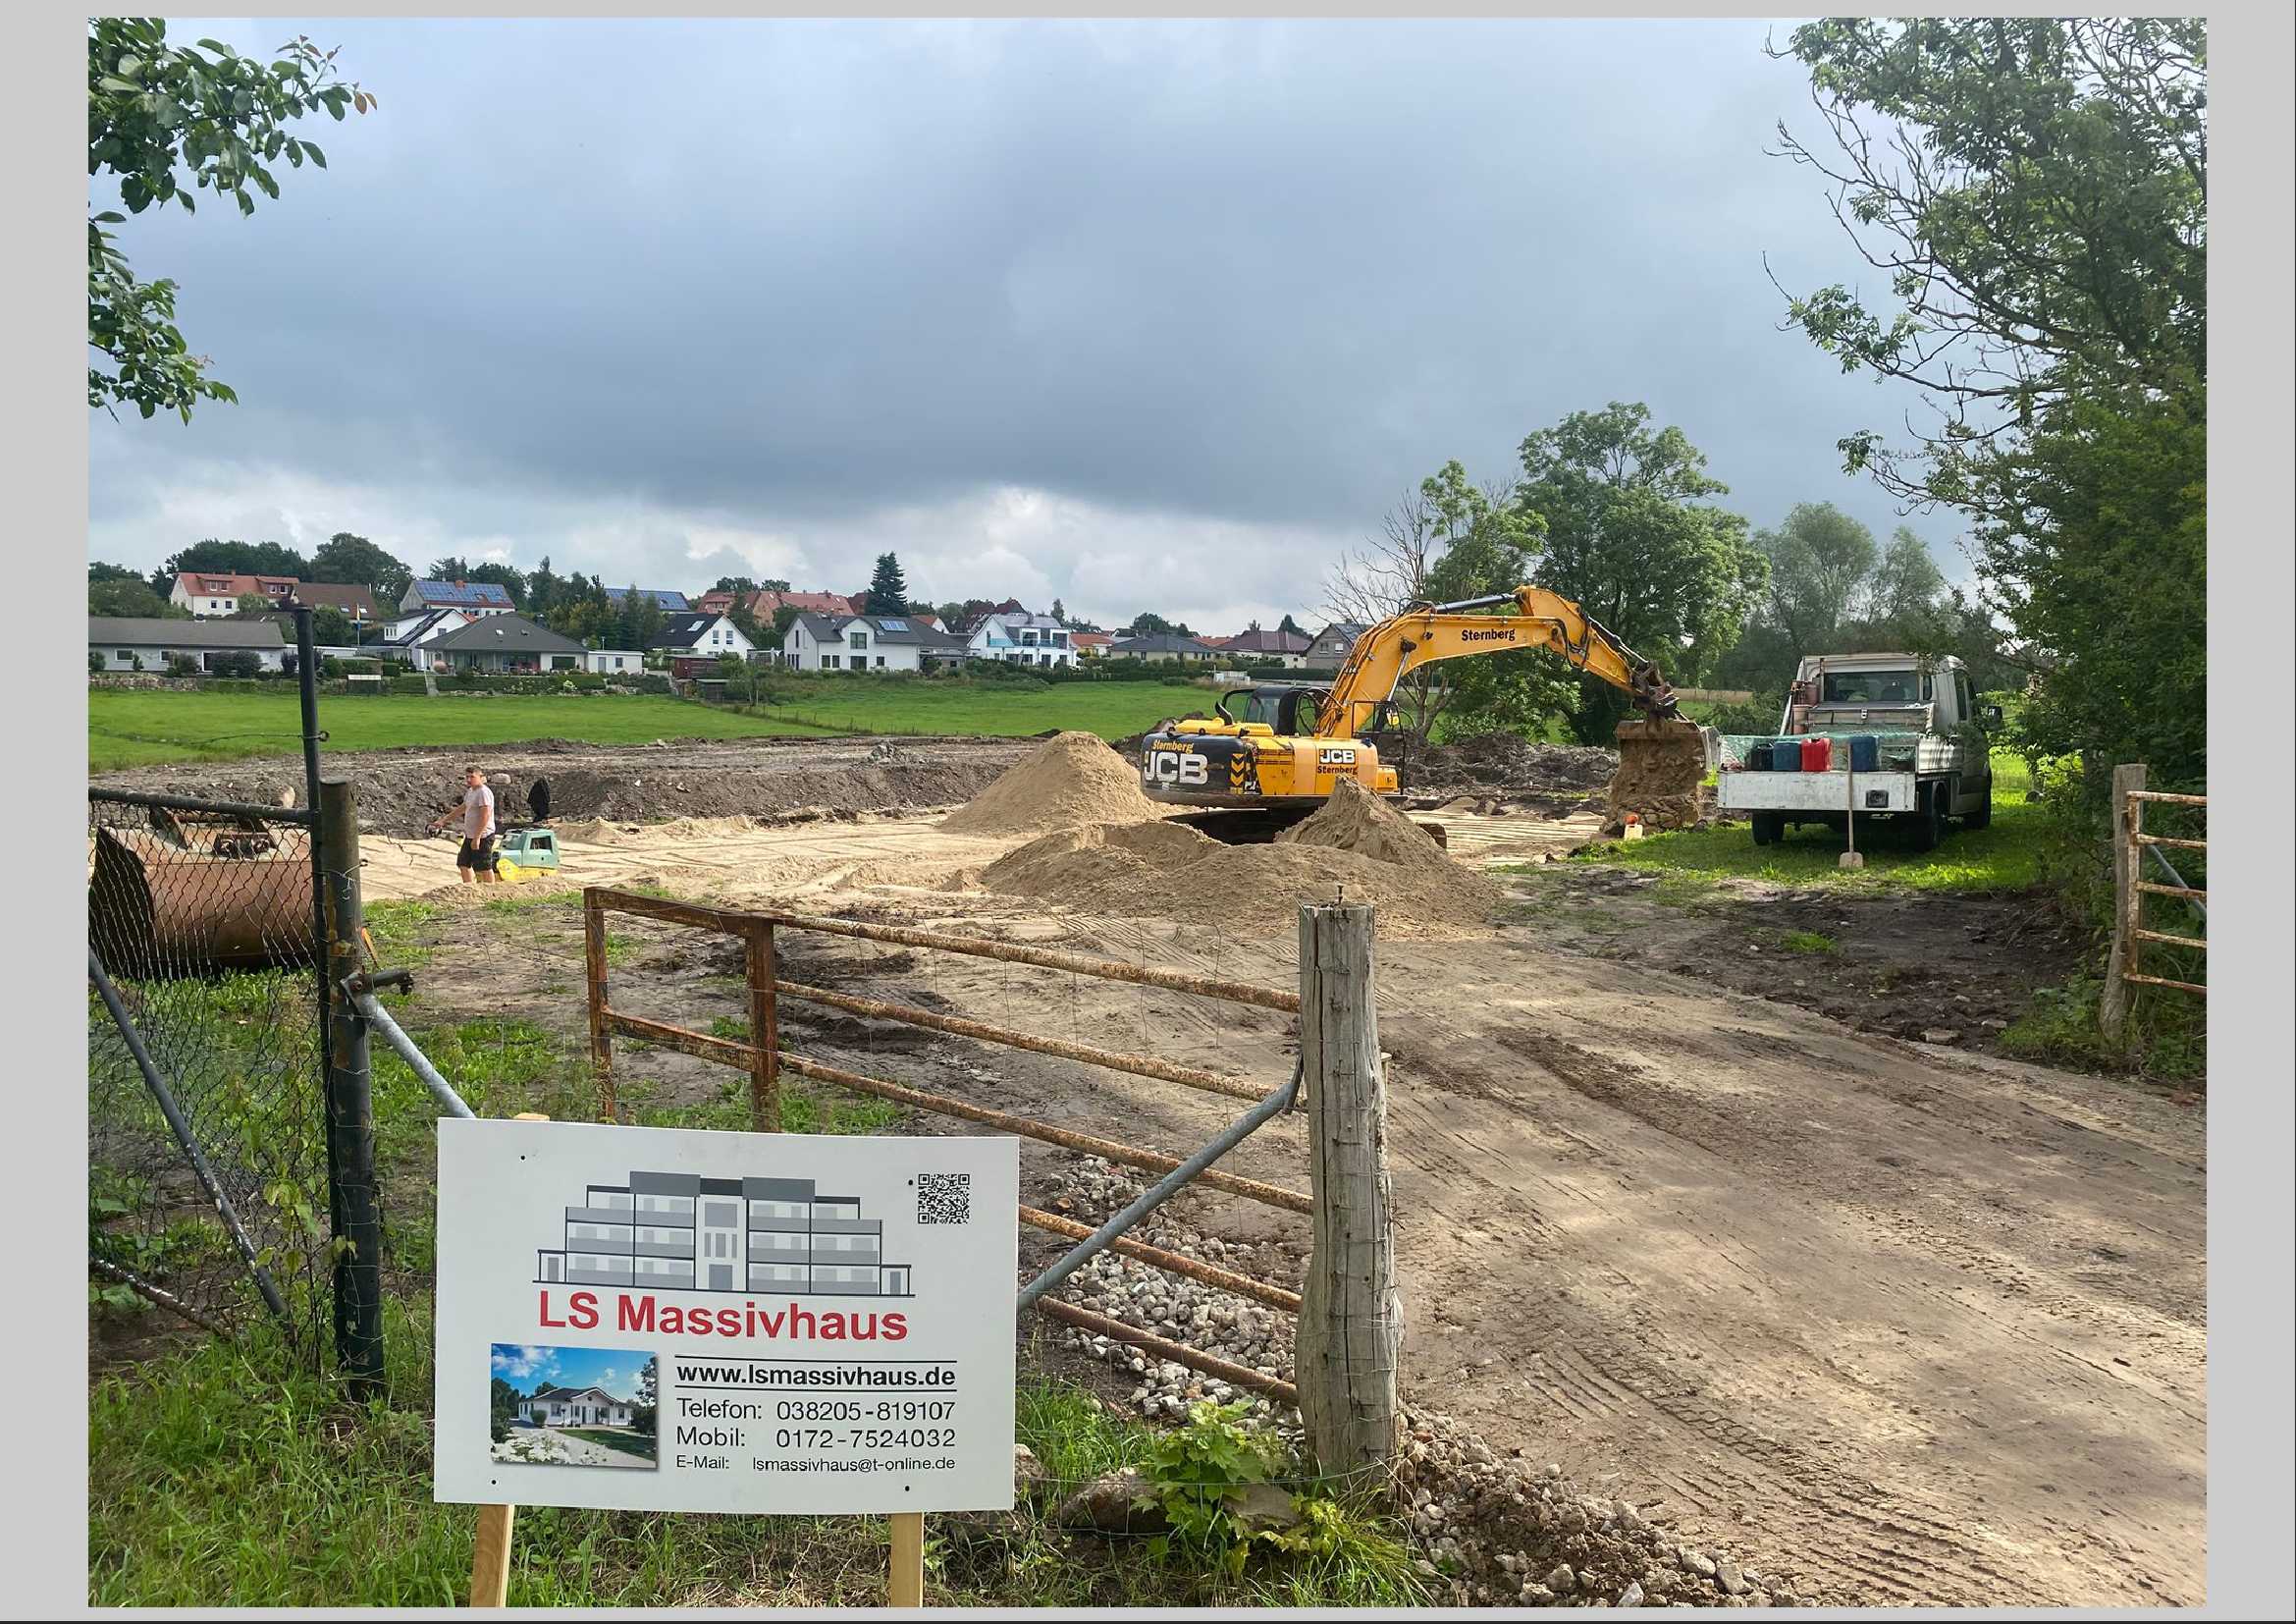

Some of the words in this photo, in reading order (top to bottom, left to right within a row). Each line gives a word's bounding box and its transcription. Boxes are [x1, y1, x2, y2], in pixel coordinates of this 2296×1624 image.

[1461, 628, 1516, 642] Sternberg
[1152, 738, 1195, 755] Sternberg
[1319, 749, 1356, 764] JCB
[1144, 750, 1208, 785] JCB
[1317, 765, 1359, 776] Sternberg
[539, 1289, 600, 1329] LS
[617, 1294, 908, 1341] Massivhaus
[676, 1364, 956, 1386] www.lsmassivhaus.de
[676, 1397, 763, 1420] Telefon:
[776, 1401, 956, 1421] 038205-819107
[676, 1426, 746, 1447] Mobil:
[775, 1429, 956, 1448] 0172-7524032
[676, 1454, 730, 1470] E-Mail:
[752, 1456, 956, 1474] lsmassivhaus@t-online.de
